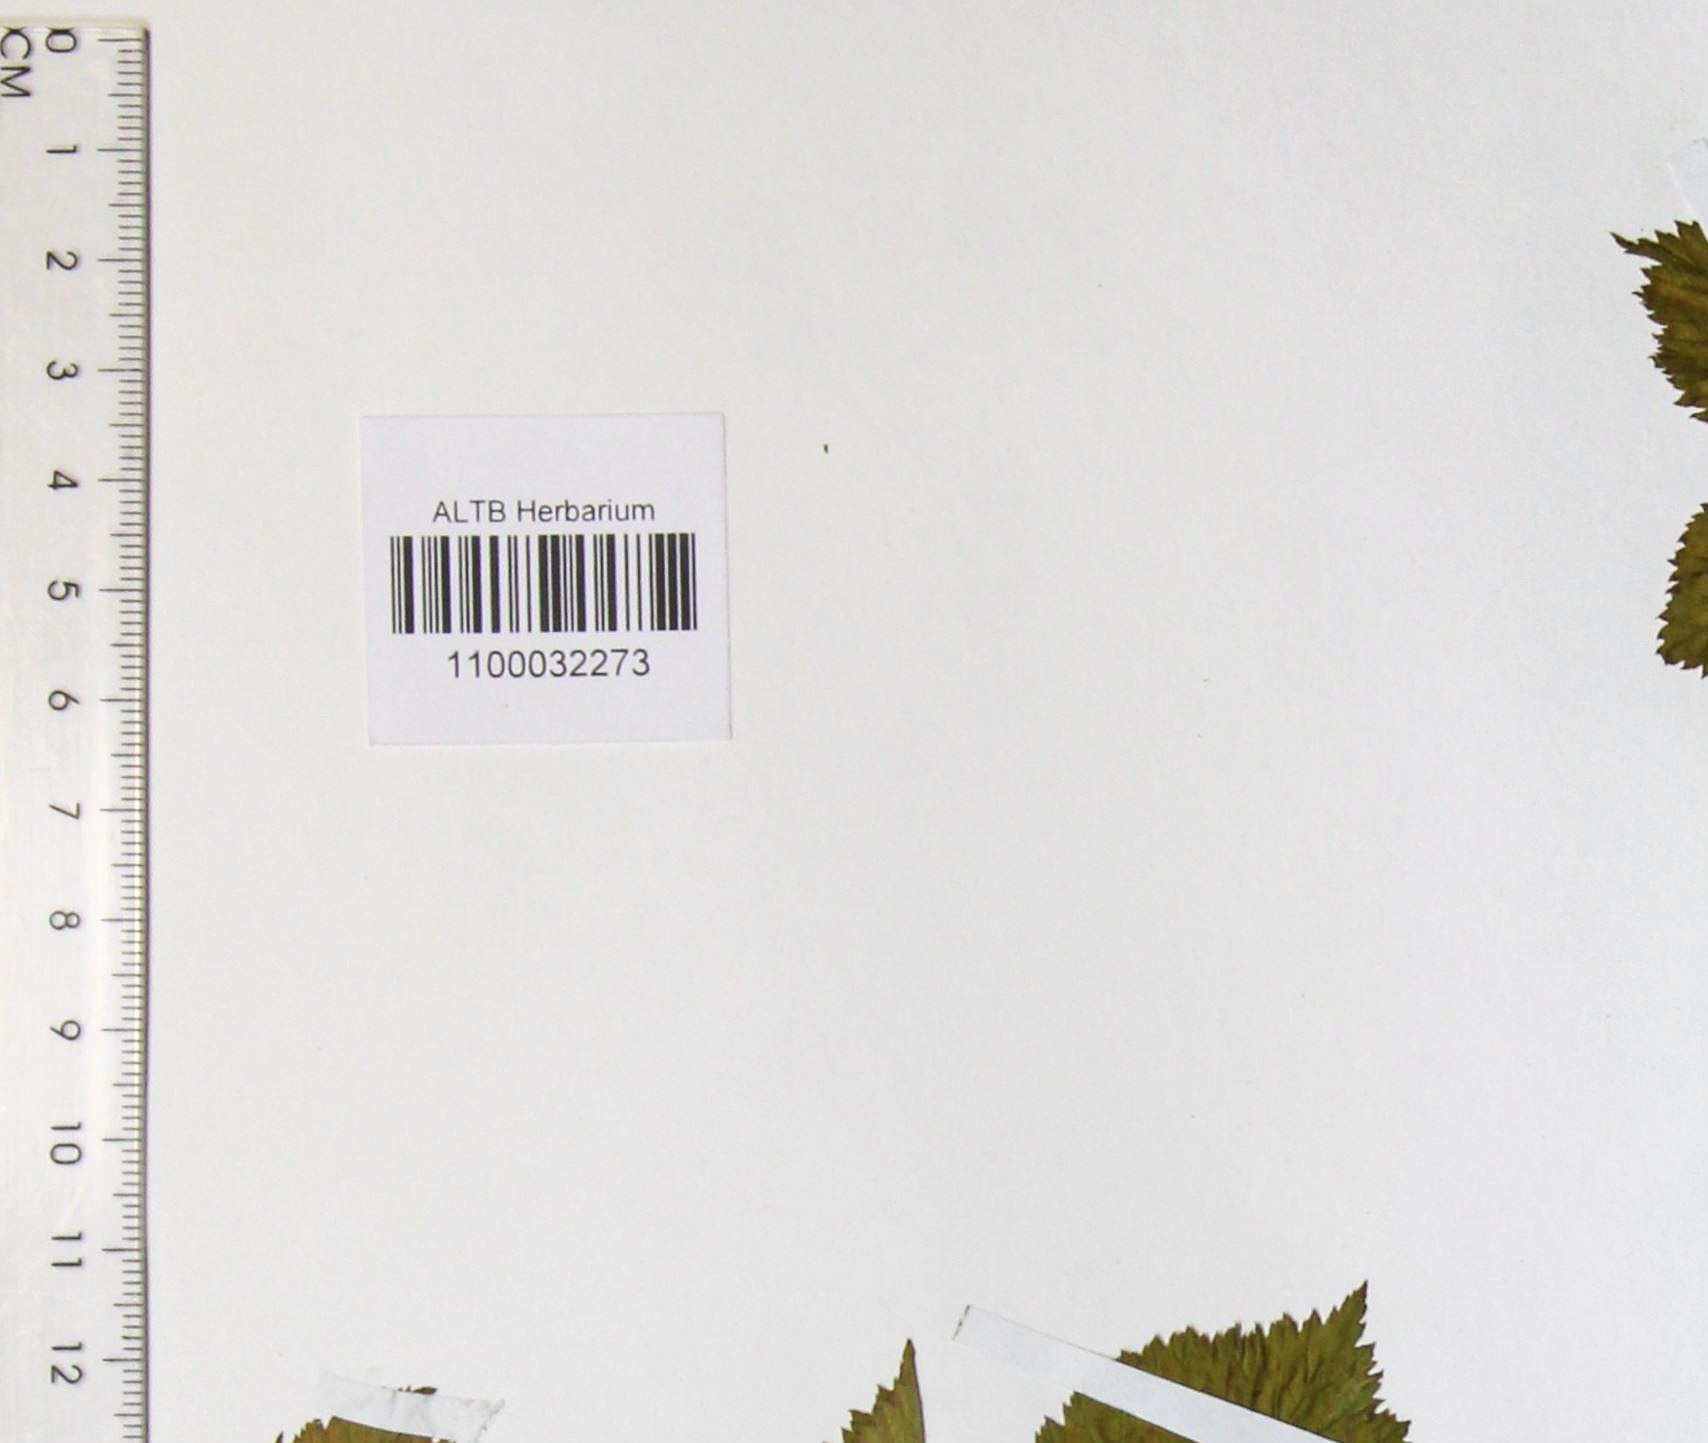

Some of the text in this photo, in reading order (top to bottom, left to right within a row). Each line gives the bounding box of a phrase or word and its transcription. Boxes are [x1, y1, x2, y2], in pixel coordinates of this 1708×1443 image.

[45, 27, 79, 53] 0
[0, 27, 34, 98] CM
[46, 145, 78, 154] 1
[46, 251, 80, 271] 2
[46, 360, 80, 381] 3
[48, 470, 80, 491] 4
[433, 499, 655, 523] ALTB Herbarium
[47, 580, 81, 601] 5
[448, 648, 650, 678] 1100032273
[48, 689, 80, 711] 6
[49, 803, 81, 820] 7
[49, 910, 82, 931] 8
[50, 1019, 82, 1041] 9
[50, 1122, 83, 1165] 10
[51, 1232, 83, 1268] 11
[51, 1342, 84, 1385] 12
